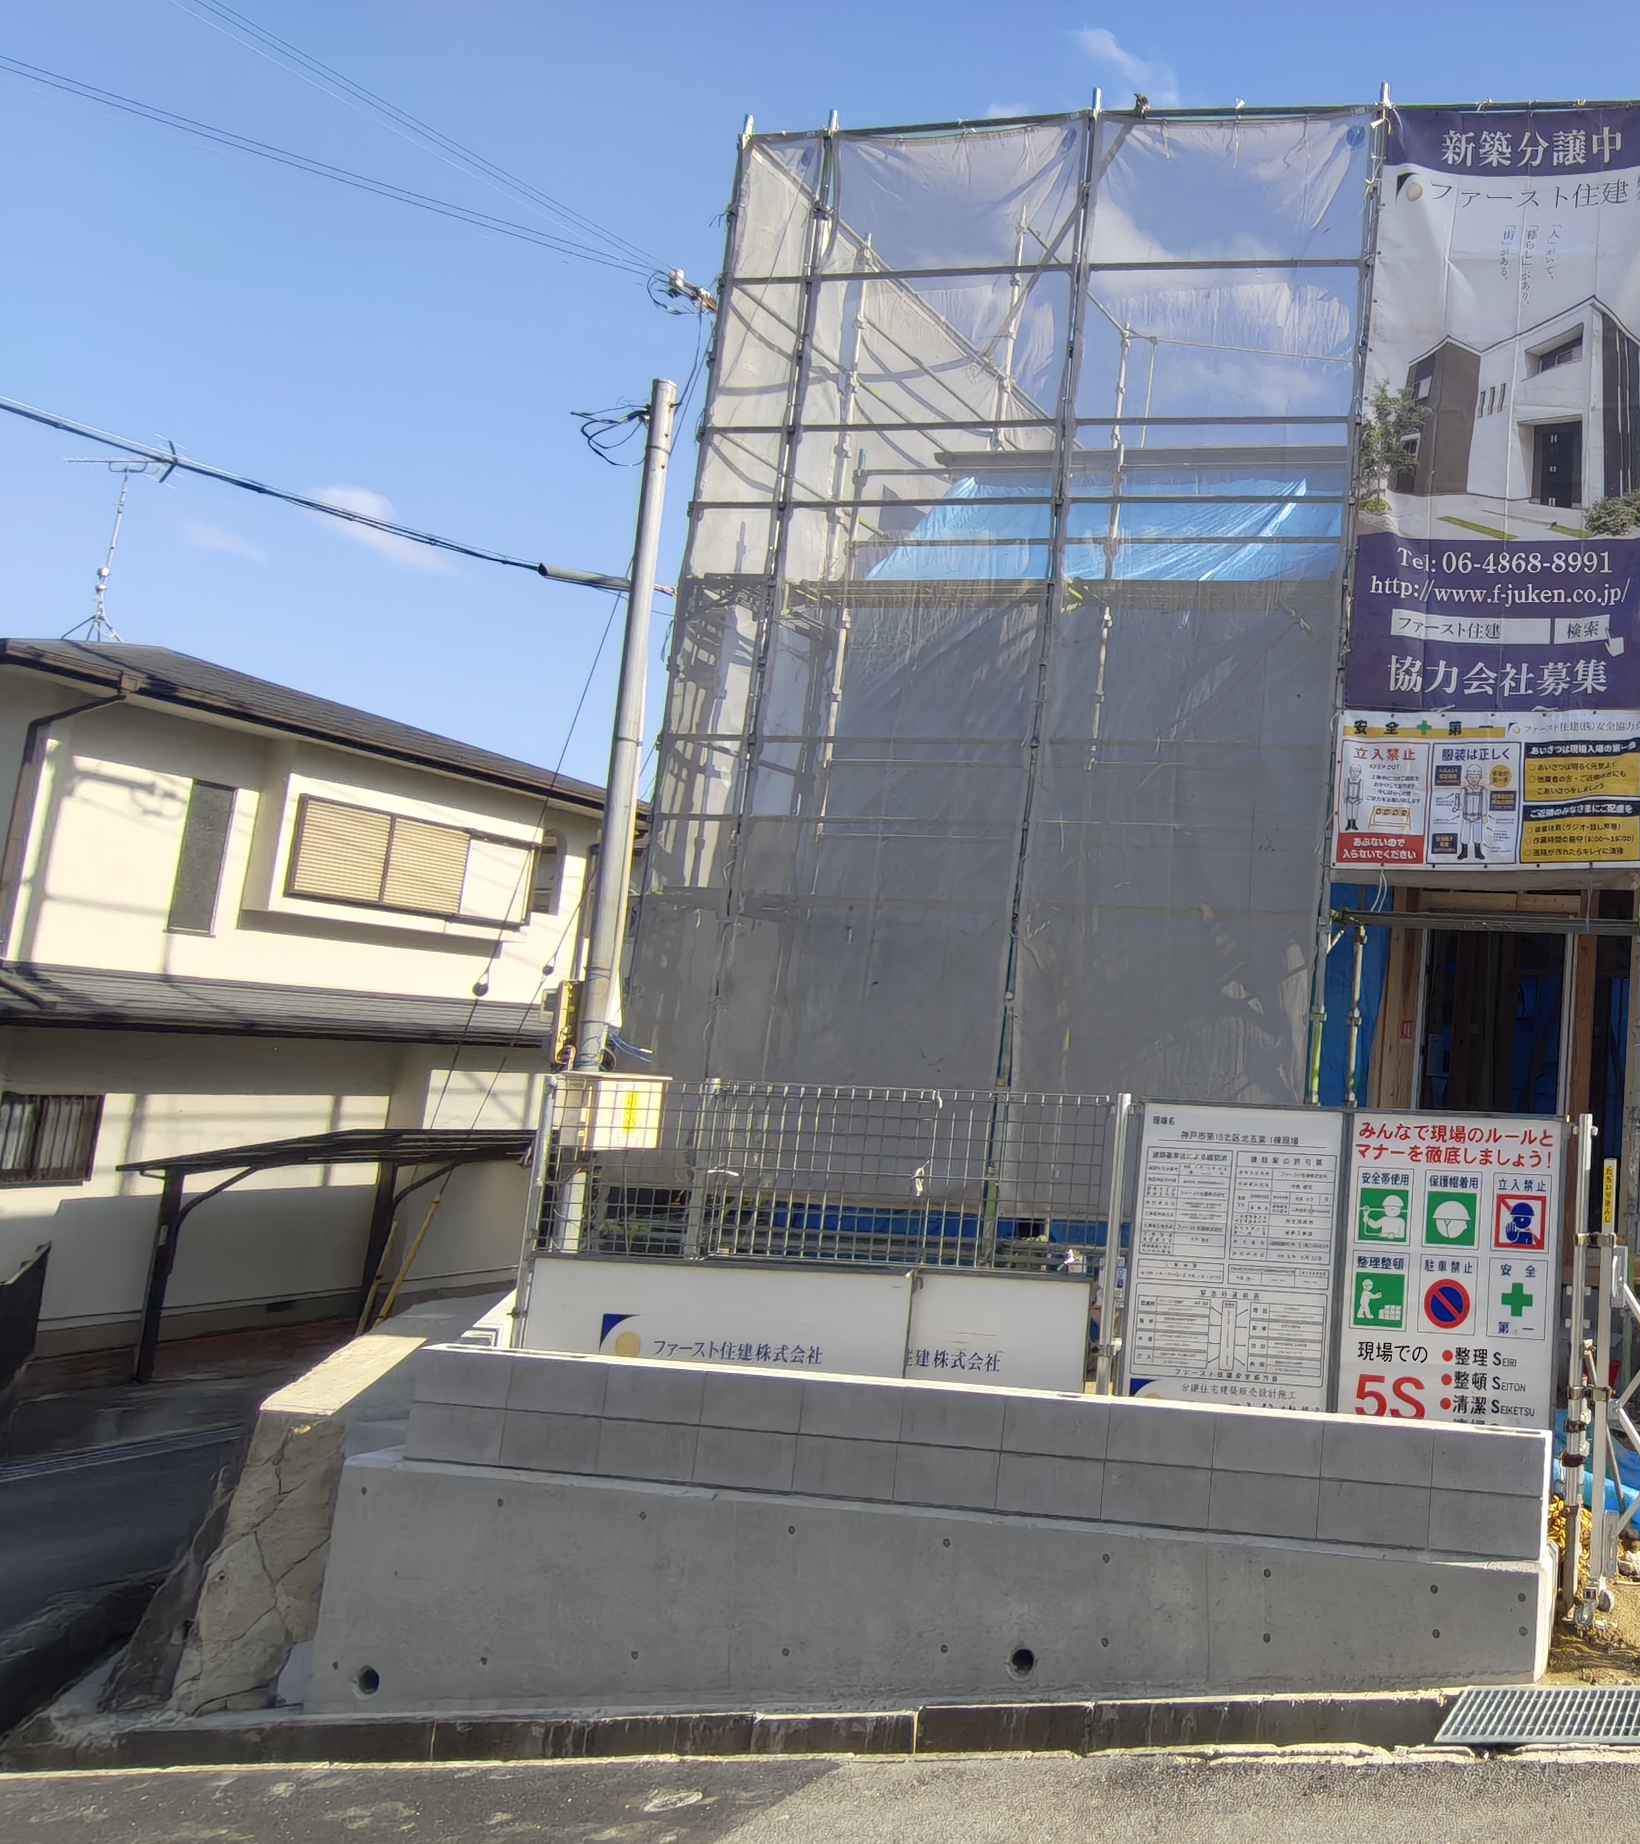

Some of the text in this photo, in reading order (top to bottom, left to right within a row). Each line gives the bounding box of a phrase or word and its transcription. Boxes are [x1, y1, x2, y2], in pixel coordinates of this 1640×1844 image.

[1440, 126, 1622, 168] 新築分譲中
[1430, 179, 1629, 209] ファースト住建
[1397, 547, 1613, 575] Tel: 06-4868-8991
[1369, 575, 1632, 608] http://www.f-juken.co.jp/
[1397, 616, 1501, 640] ファースト住建
[1566, 620, 1600, 640] 検索
[1388, 654, 1608, 697] 協力会社募集
[1353, 747, 1416, 761] 立入禁止
[1442, 747, 1510, 761] 服装は正しく
[1358, 1122, 1554, 1147] みんなで現場のルールと
[1355, 1143, 1552, 1169] マナーを徹底しましょう!
[1361, 1172, 1410, 1186] 安全帯使用
[1429, 1175, 1479, 1190] 保護帽着用
[1497, 1178, 1547, 1192] 立入禁止
[1356, 1256, 1405, 1270] 整理整頓
[1424, 1259, 1473, 1274] 駐車禁止
[1500, 1263, 1537, 1278] 安全
[1498, 1321, 1534, 1334] 第一
[653, 1340, 823, 1365] ファースト住建株式会社
[1357, 1341, 1428, 1364] 現場での
[1455, 1347, 1488, 1367] 整理
[1454, 1371, 1488, 1391] 整頓
[1355, 1373, 1426, 1420] 5S
[1452, 1394, 1487, 1415] 清潔
